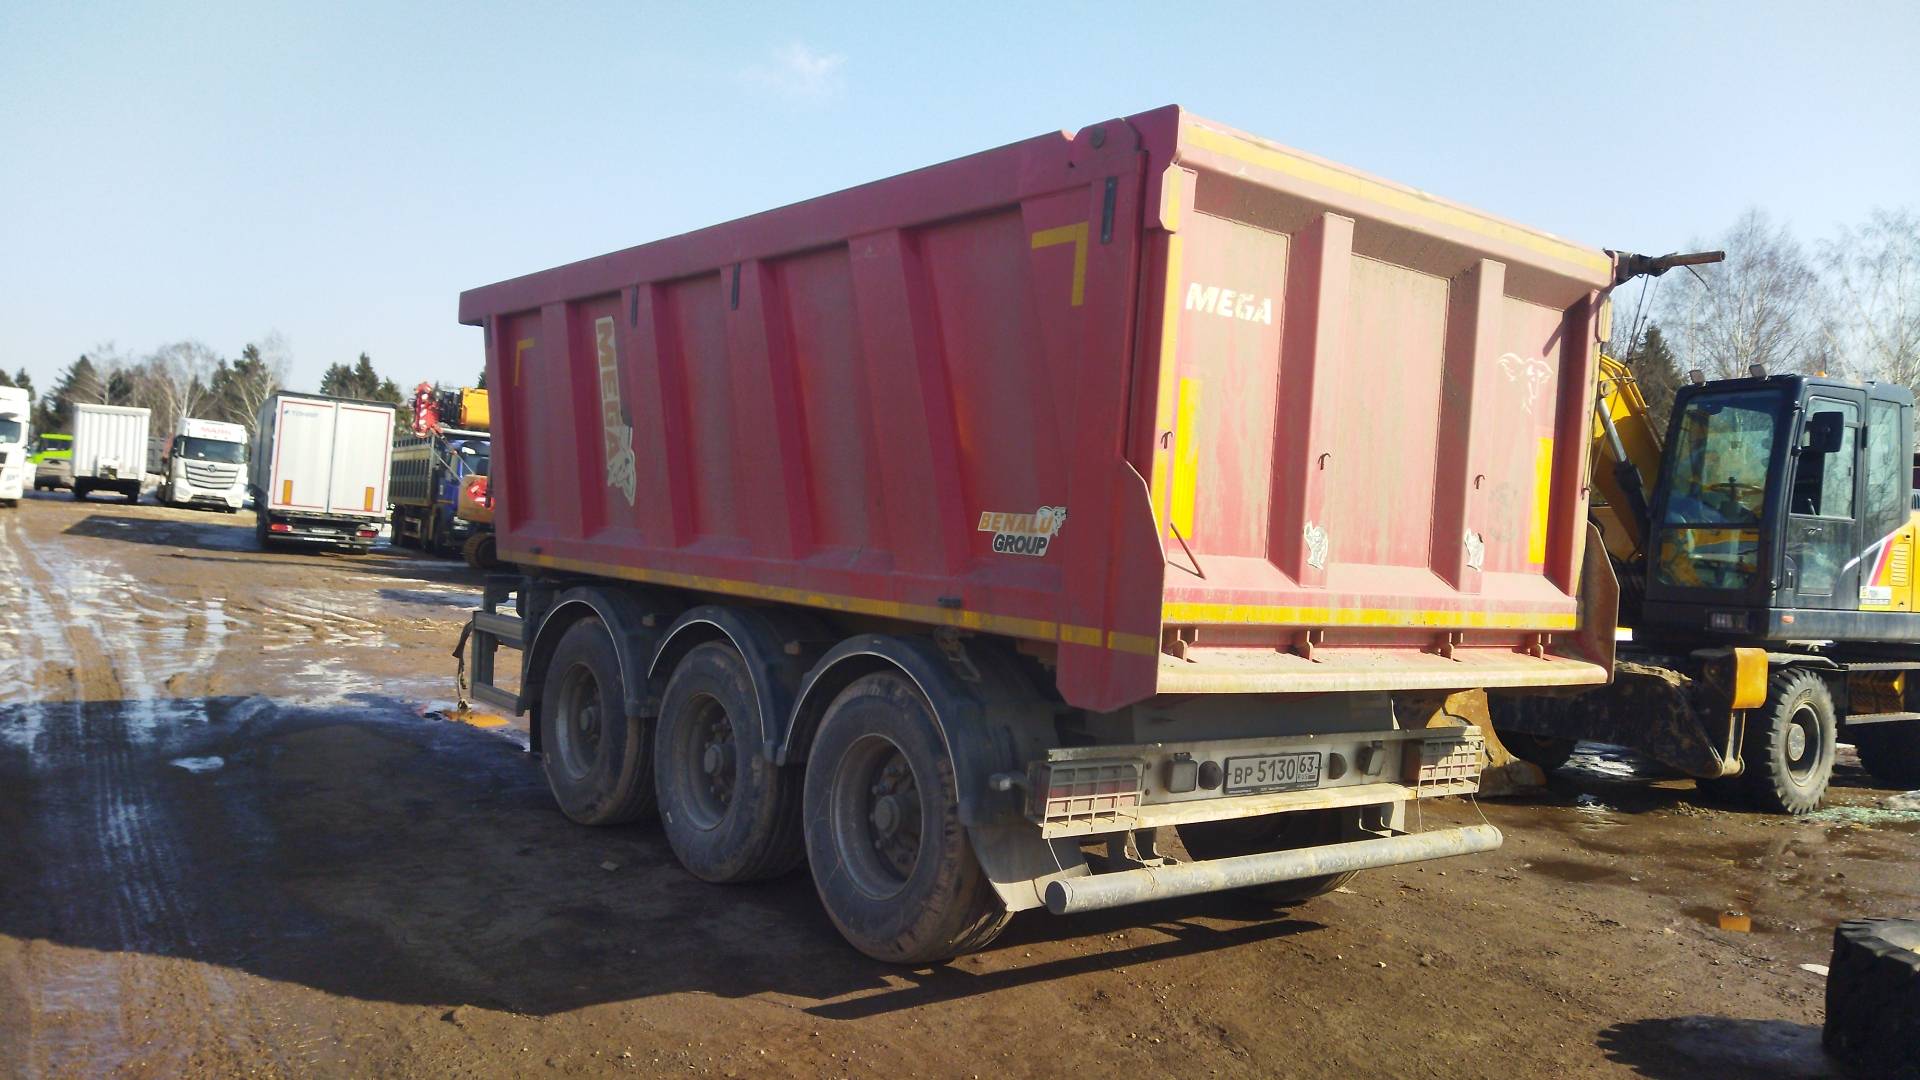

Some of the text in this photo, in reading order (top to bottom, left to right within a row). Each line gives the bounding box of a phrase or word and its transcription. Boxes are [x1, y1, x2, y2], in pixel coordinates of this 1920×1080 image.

[1185, 282, 1272, 325] MEGA
[980, 512, 1055, 533] BENALU
[993, 534, 1048, 554] GROUP
[1300, 756, 1315, 773] 63
